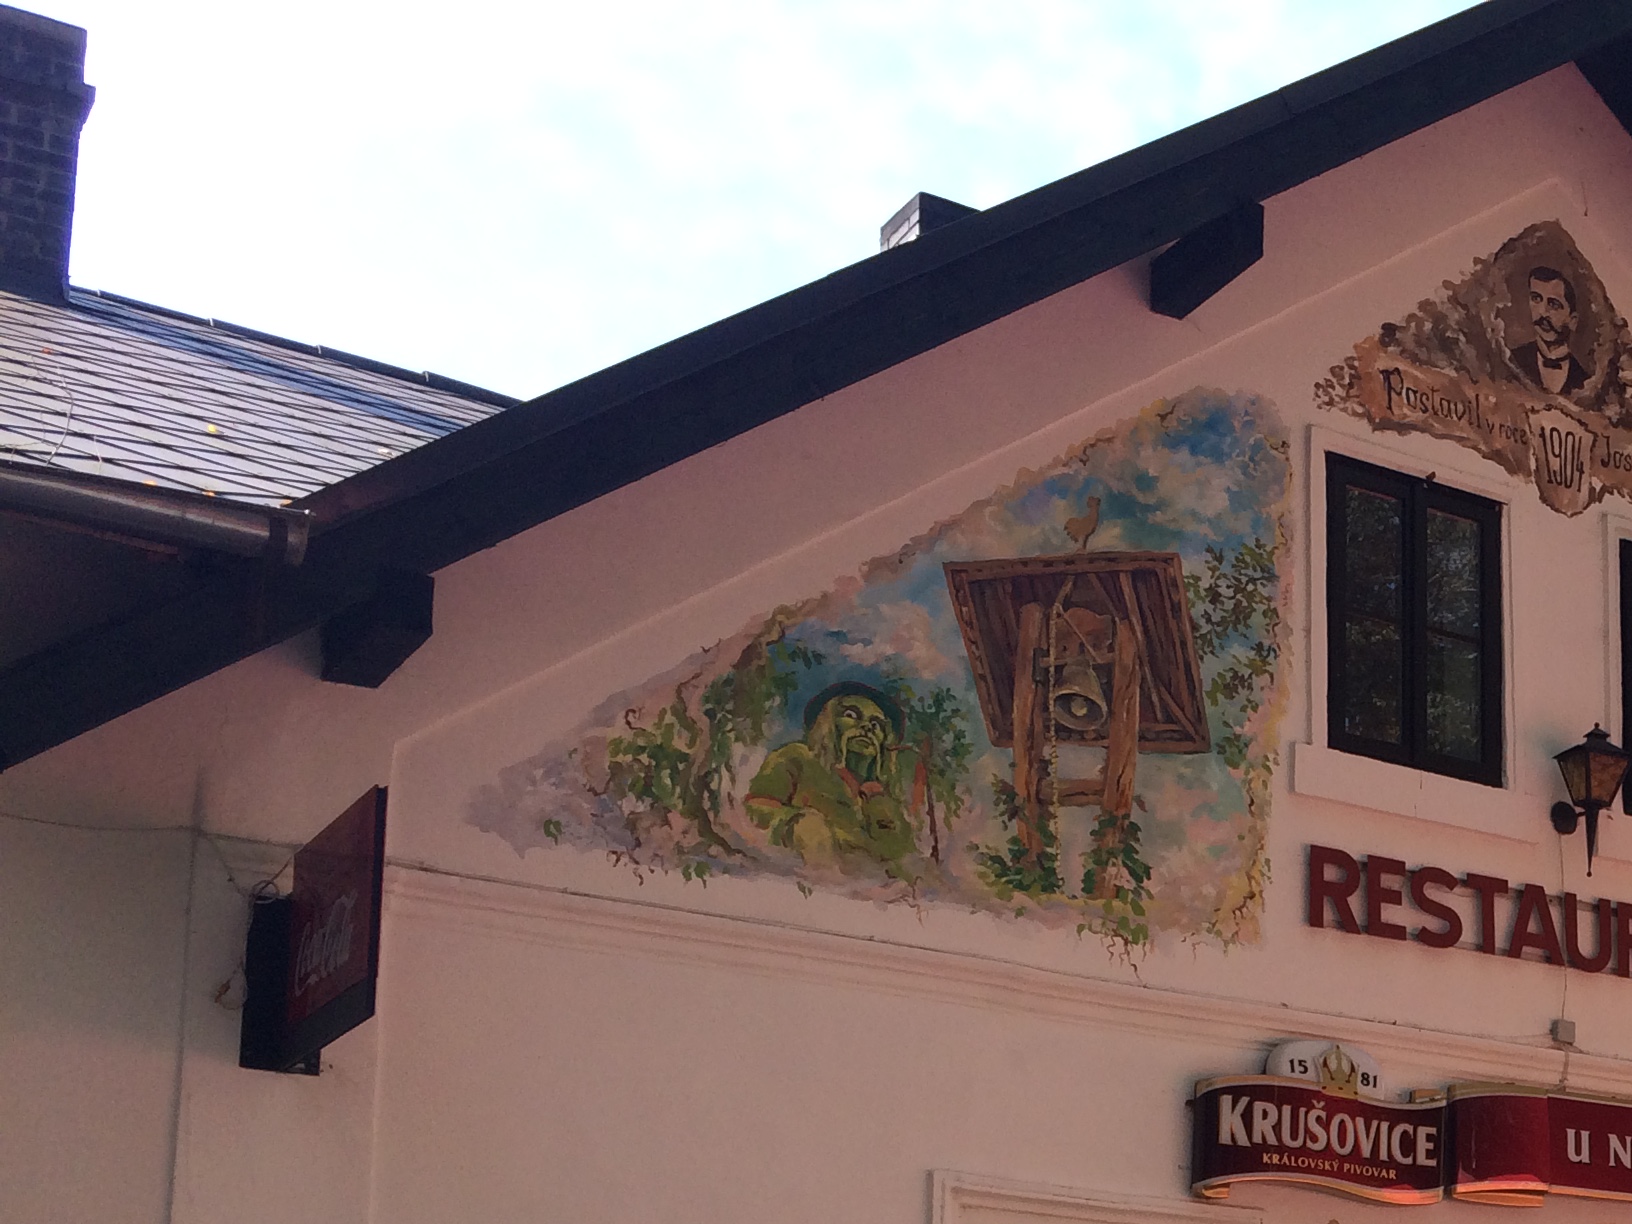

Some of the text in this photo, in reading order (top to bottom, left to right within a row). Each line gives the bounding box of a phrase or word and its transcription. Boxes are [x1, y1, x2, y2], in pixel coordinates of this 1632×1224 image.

[1378, 367, 1482, 429] Postavil
[1485, 416, 1495, 435] v
[1498, 422, 1528, 446] roce
[1539, 426, 1585, 494] 1904
[1289, 1058, 1378, 1089] 15 81
[1218, 1095, 1438, 1167] KRUŠOVICE
[1566, 1128, 1591, 1164] U
[1262, 1152, 1397, 1180] KRÁLOVSKÝ PIVOVAR
